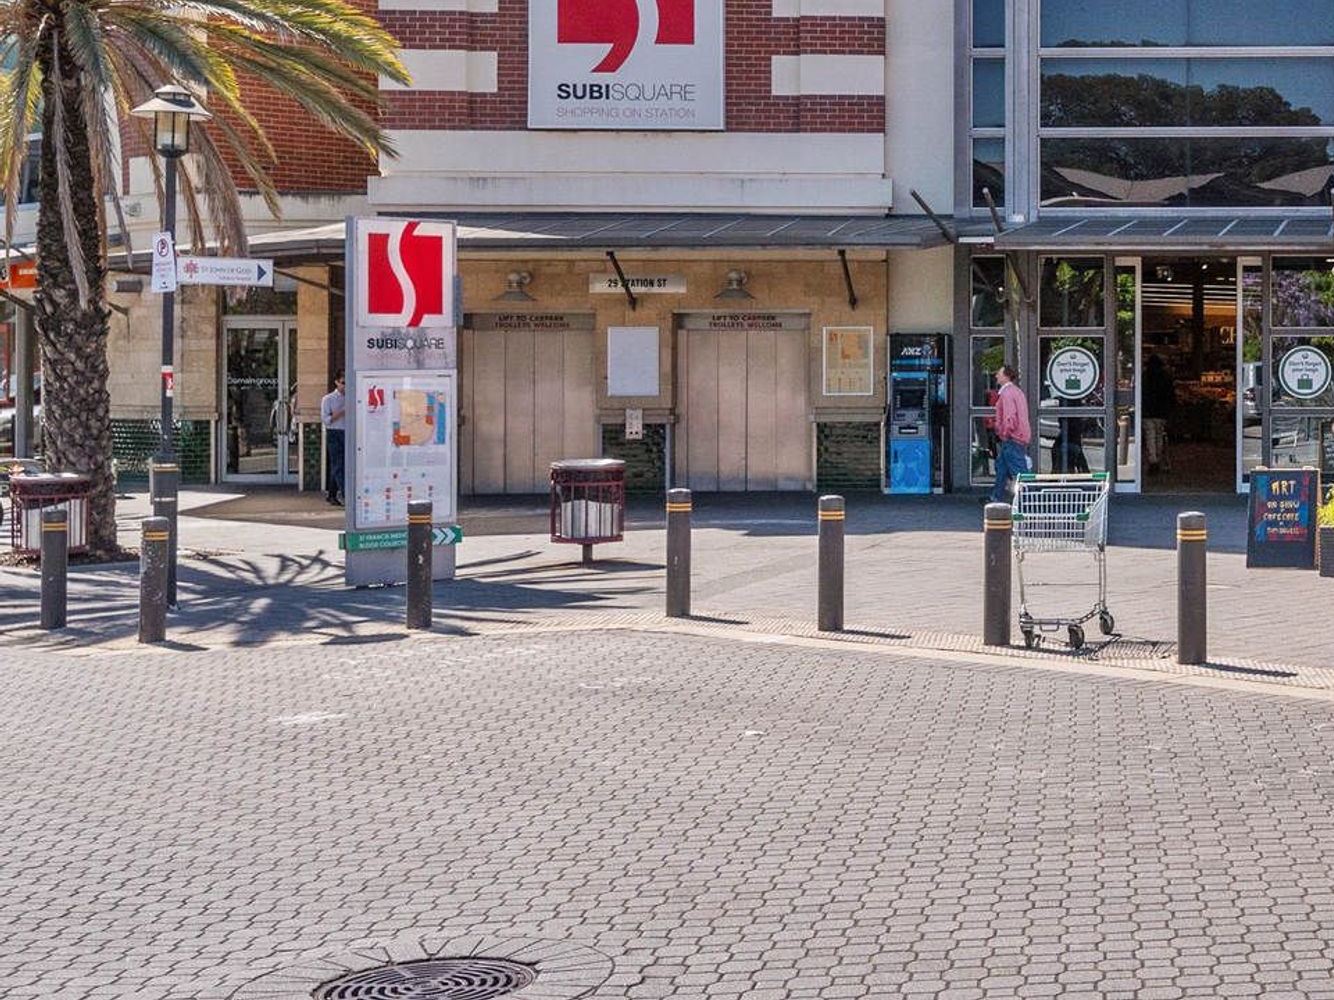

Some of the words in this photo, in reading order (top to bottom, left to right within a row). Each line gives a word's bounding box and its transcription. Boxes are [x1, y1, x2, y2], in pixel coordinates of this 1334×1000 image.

[556, 82, 697, 101] SUBISQUARE
[555, 106, 619, 118] SHOPPING
[622, 106, 642, 118] ON
[644, 107, 696, 119] STATION
[620, 278, 654, 288] TATION
[657, 278, 667, 288] ST
[366, 337, 445, 350] SUBISQUARE
[900, 346, 922, 356] ANZ
[1271, 480, 1297, 496] ART
